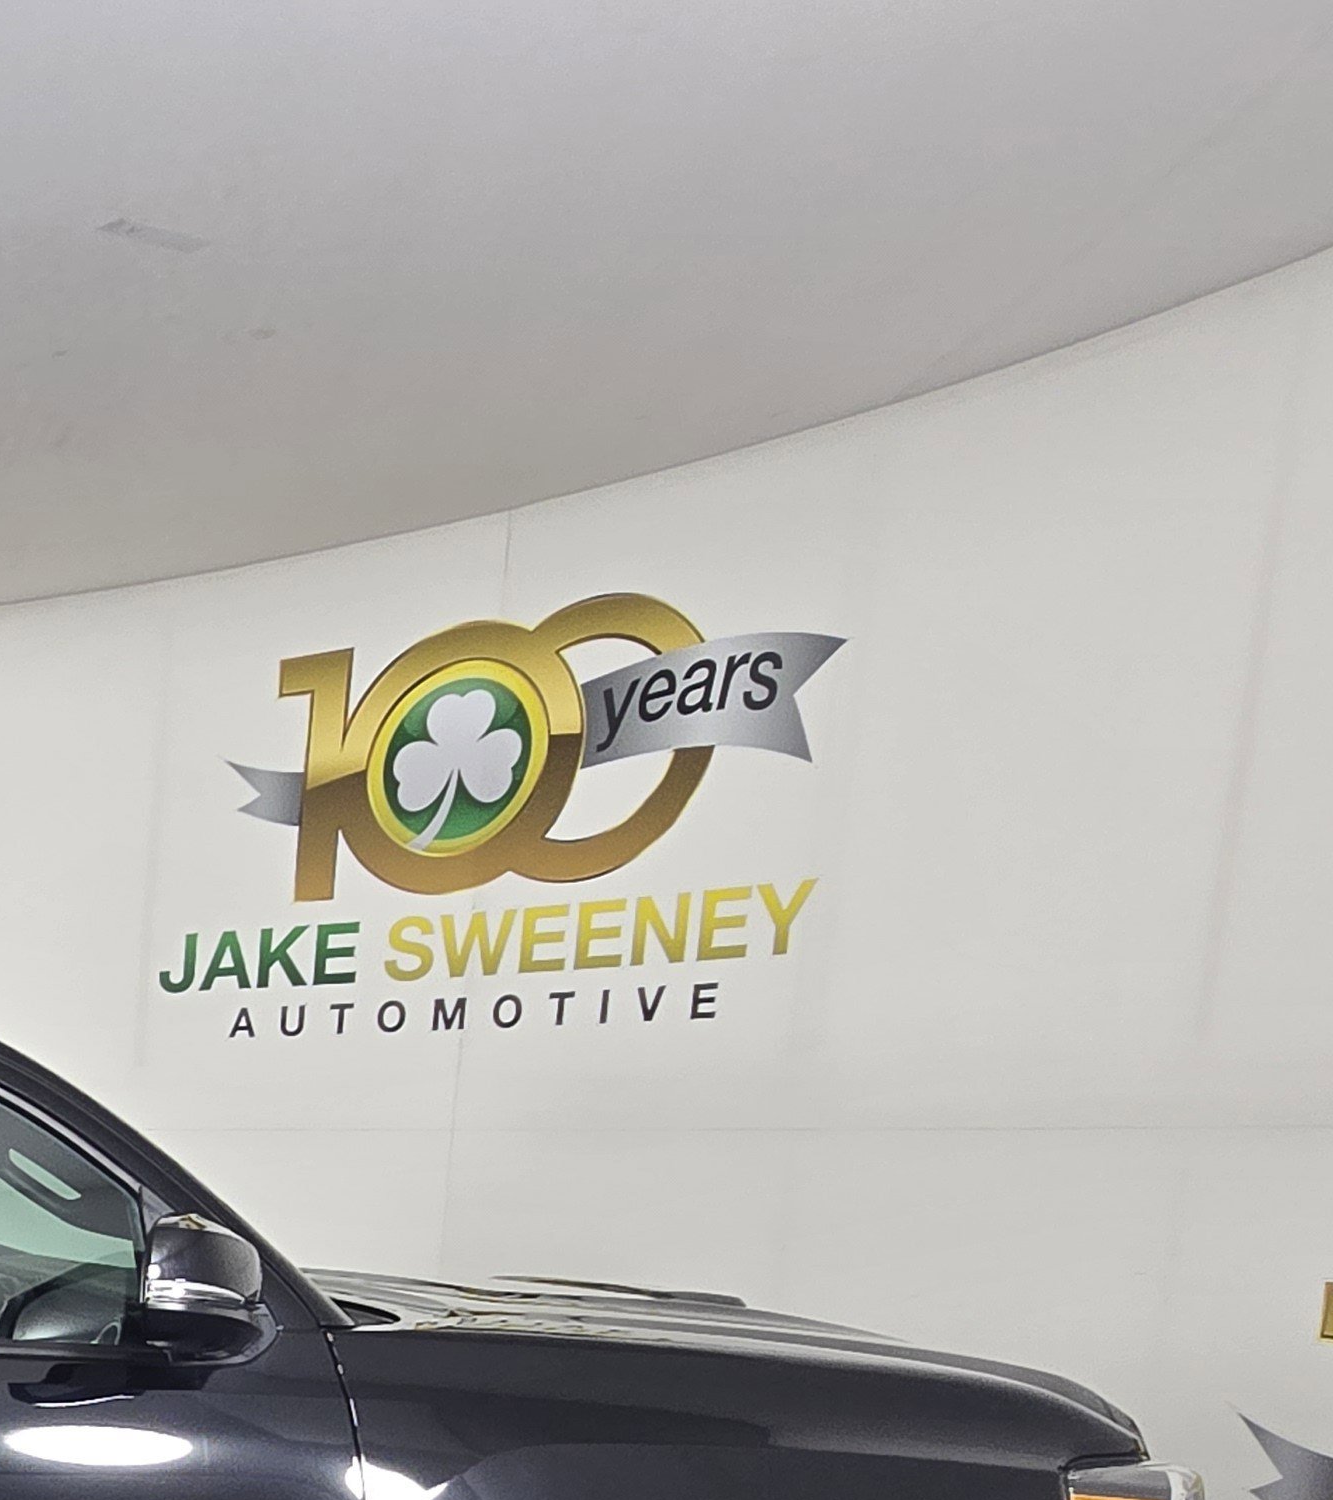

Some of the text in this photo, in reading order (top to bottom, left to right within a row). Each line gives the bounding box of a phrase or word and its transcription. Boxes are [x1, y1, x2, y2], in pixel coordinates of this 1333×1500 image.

[596, 650, 783, 754] years
[158, 877, 820, 995] JAKE SWEENEY
[229, 982, 721, 1040] AUTOMOTIVE
